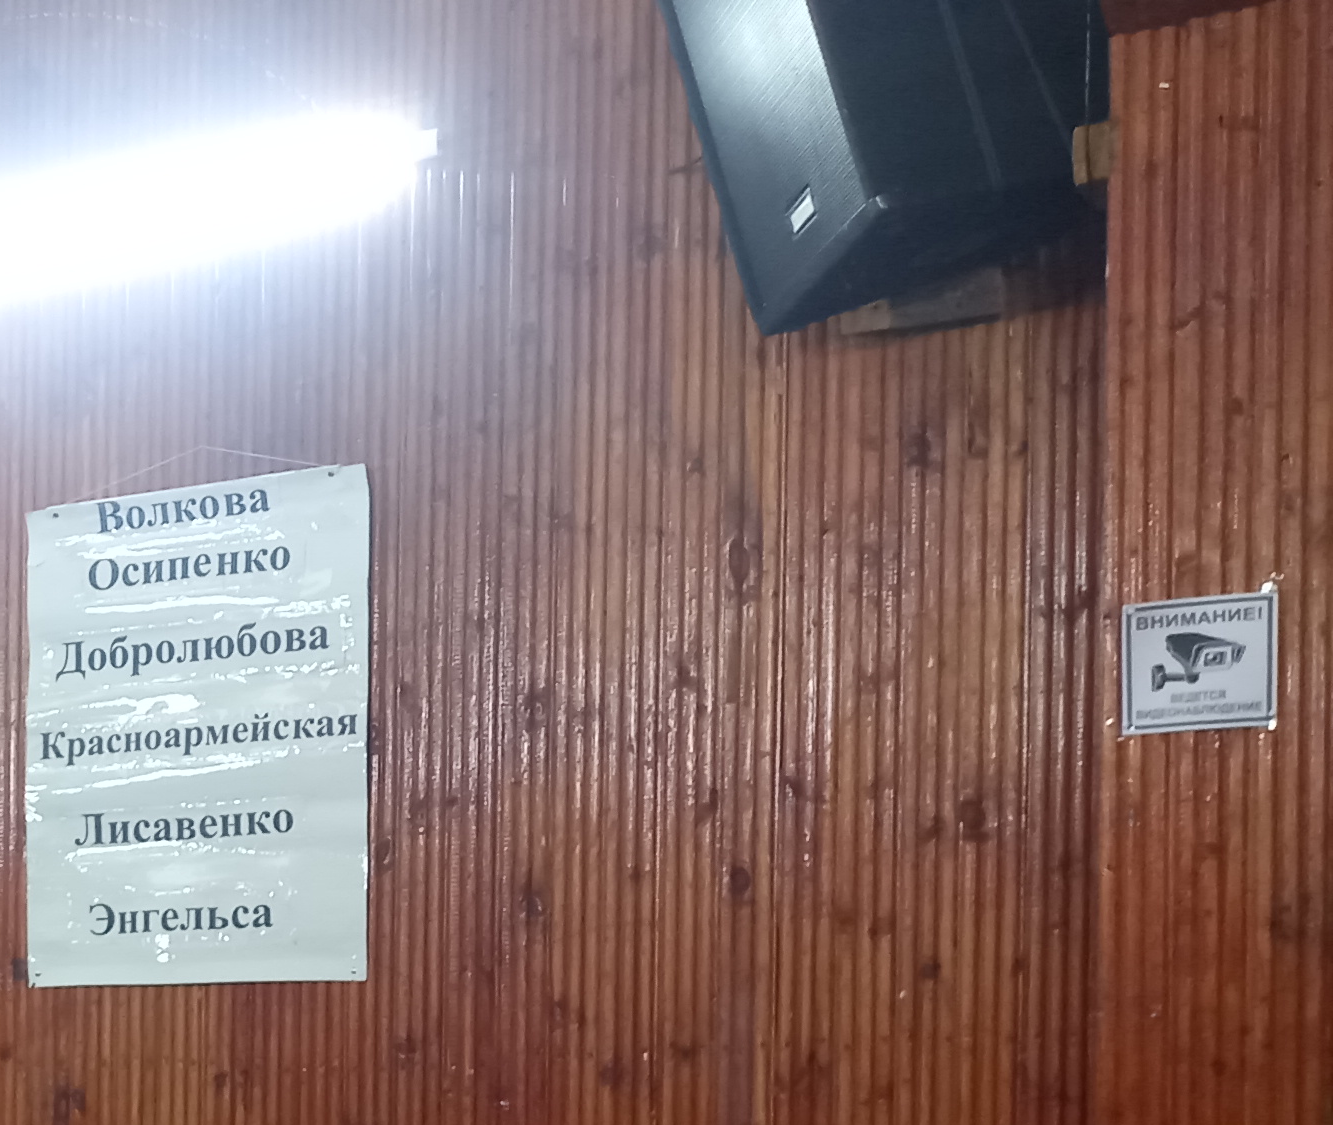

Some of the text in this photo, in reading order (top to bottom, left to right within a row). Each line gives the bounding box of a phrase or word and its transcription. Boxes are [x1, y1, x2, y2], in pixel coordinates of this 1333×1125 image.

[96, 488, 270, 534] Волкова
[87, 544, 290, 590] Осипенко
[1135, 607, 1263, 631] ВНИМАНИЕ!
[56, 623, 329, 679] Добролюбова
[40, 711, 357, 766] Красноармейская
[74, 808, 294, 847] Лисавенко
[88, 902, 273, 936] Энгельса
